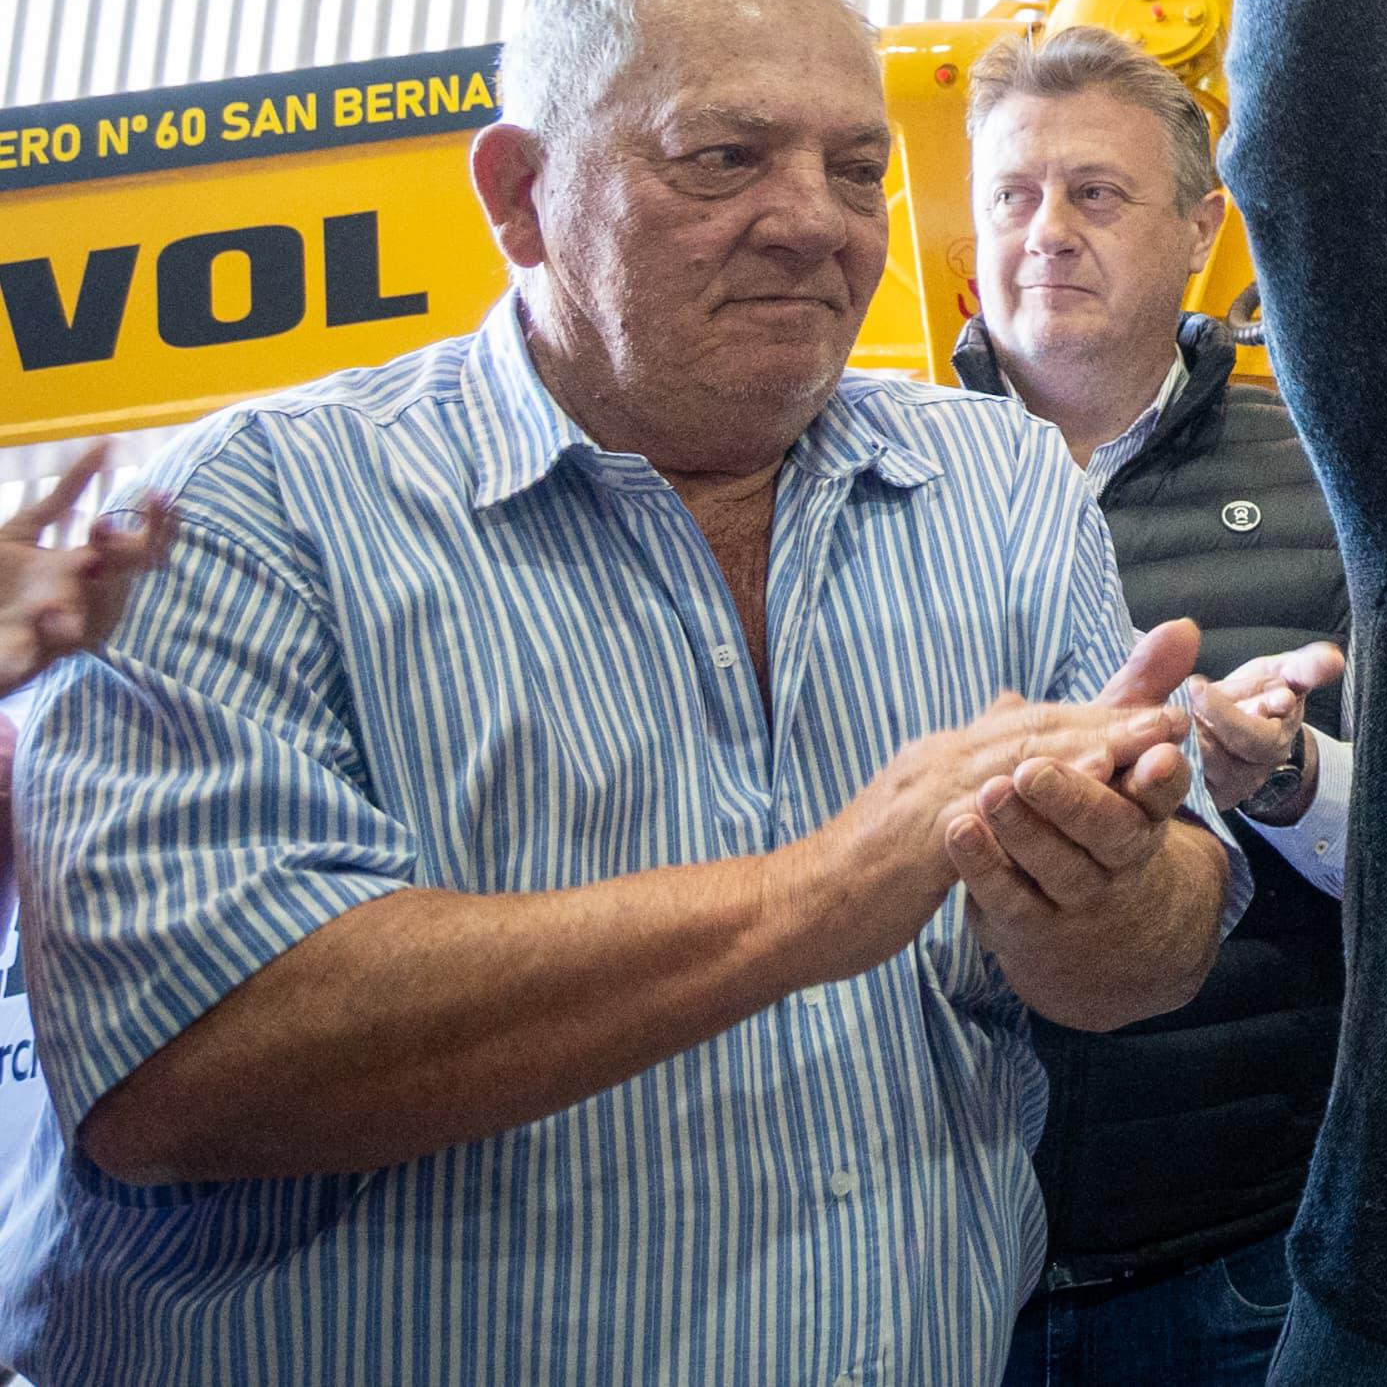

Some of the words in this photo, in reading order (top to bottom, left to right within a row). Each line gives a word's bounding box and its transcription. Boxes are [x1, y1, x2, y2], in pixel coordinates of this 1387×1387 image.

[221, 93, 317, 141] SAN
[333, 72, 503, 127] BERNA
[0, 211, 428, 371] VOL
